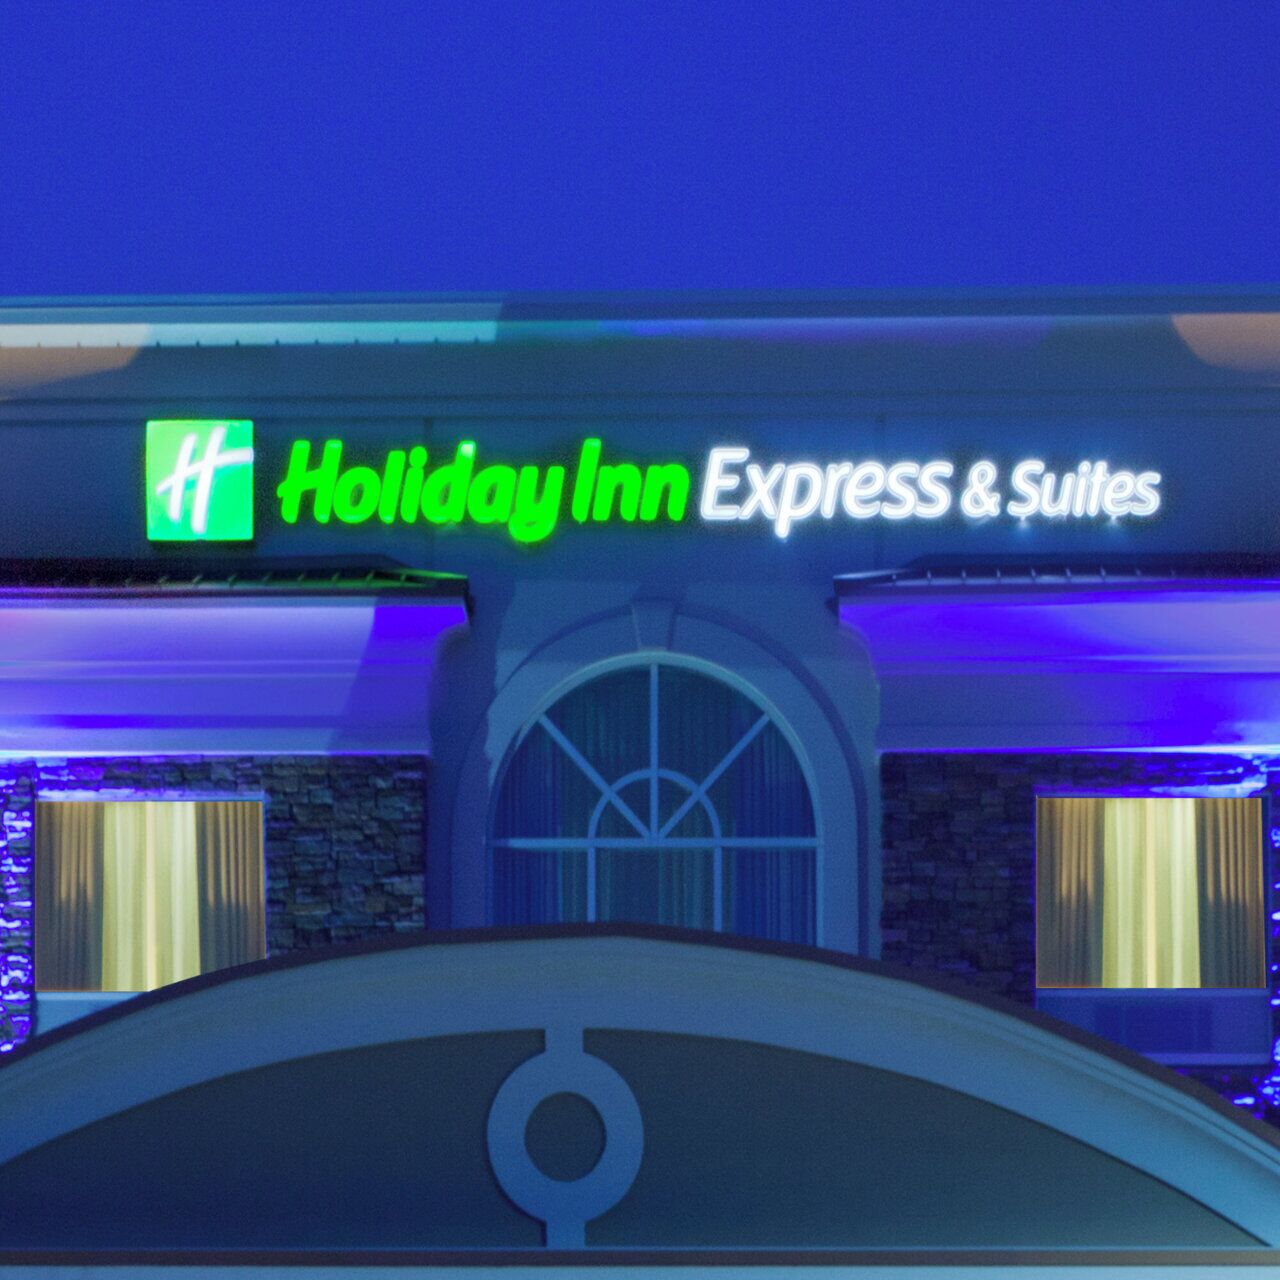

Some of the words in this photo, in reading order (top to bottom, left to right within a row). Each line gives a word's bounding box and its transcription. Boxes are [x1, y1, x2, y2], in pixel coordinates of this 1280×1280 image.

[156, 427, 254, 534] H
[277, 439, 565, 542] Holiday
[571, 438, 690, 523] Inn
[700, 447, 953, 538] Express
[961, 460, 1000, 518] &
[1007, 459, 1161, 518] Suites
